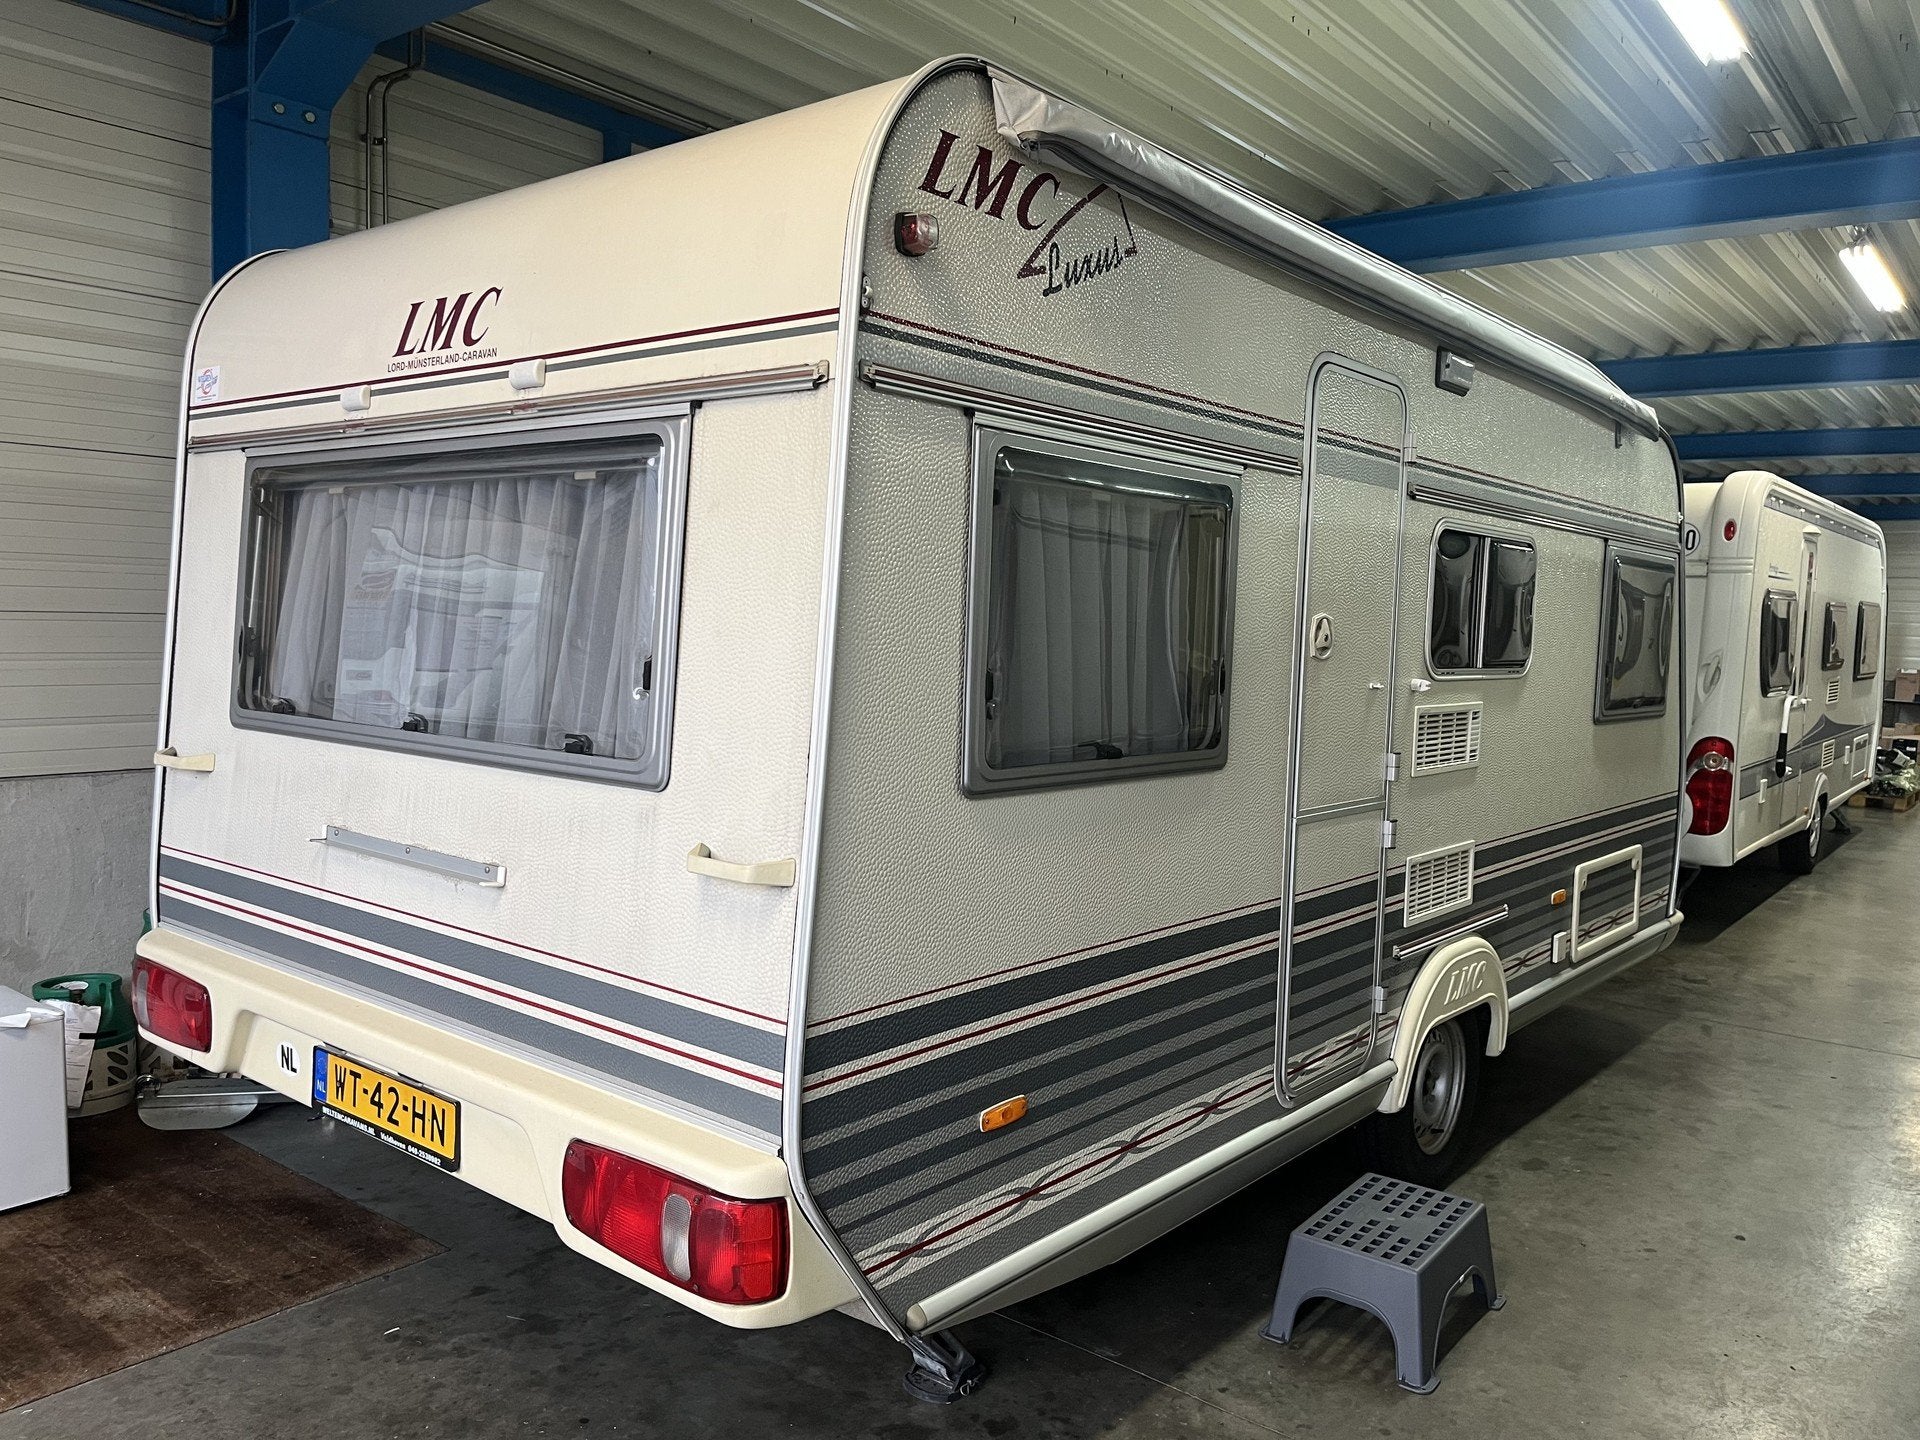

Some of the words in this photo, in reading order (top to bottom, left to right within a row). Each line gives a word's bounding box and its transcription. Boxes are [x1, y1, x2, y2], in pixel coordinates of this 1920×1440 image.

[918, 128, 1061, 231] LMC
[1042, 236, 1124, 297] Luxus
[392, 286, 503, 358] LMC
[387, 347, 498, 373] LORD-MÜNSTERLAND-CARAVAN
[1443, 960, 1487, 1006] LMC
[280, 1044, 298, 1074] NL
[316, 1079, 326, 1094] NL
[334, 1063, 446, 1147] WT-42-HN
